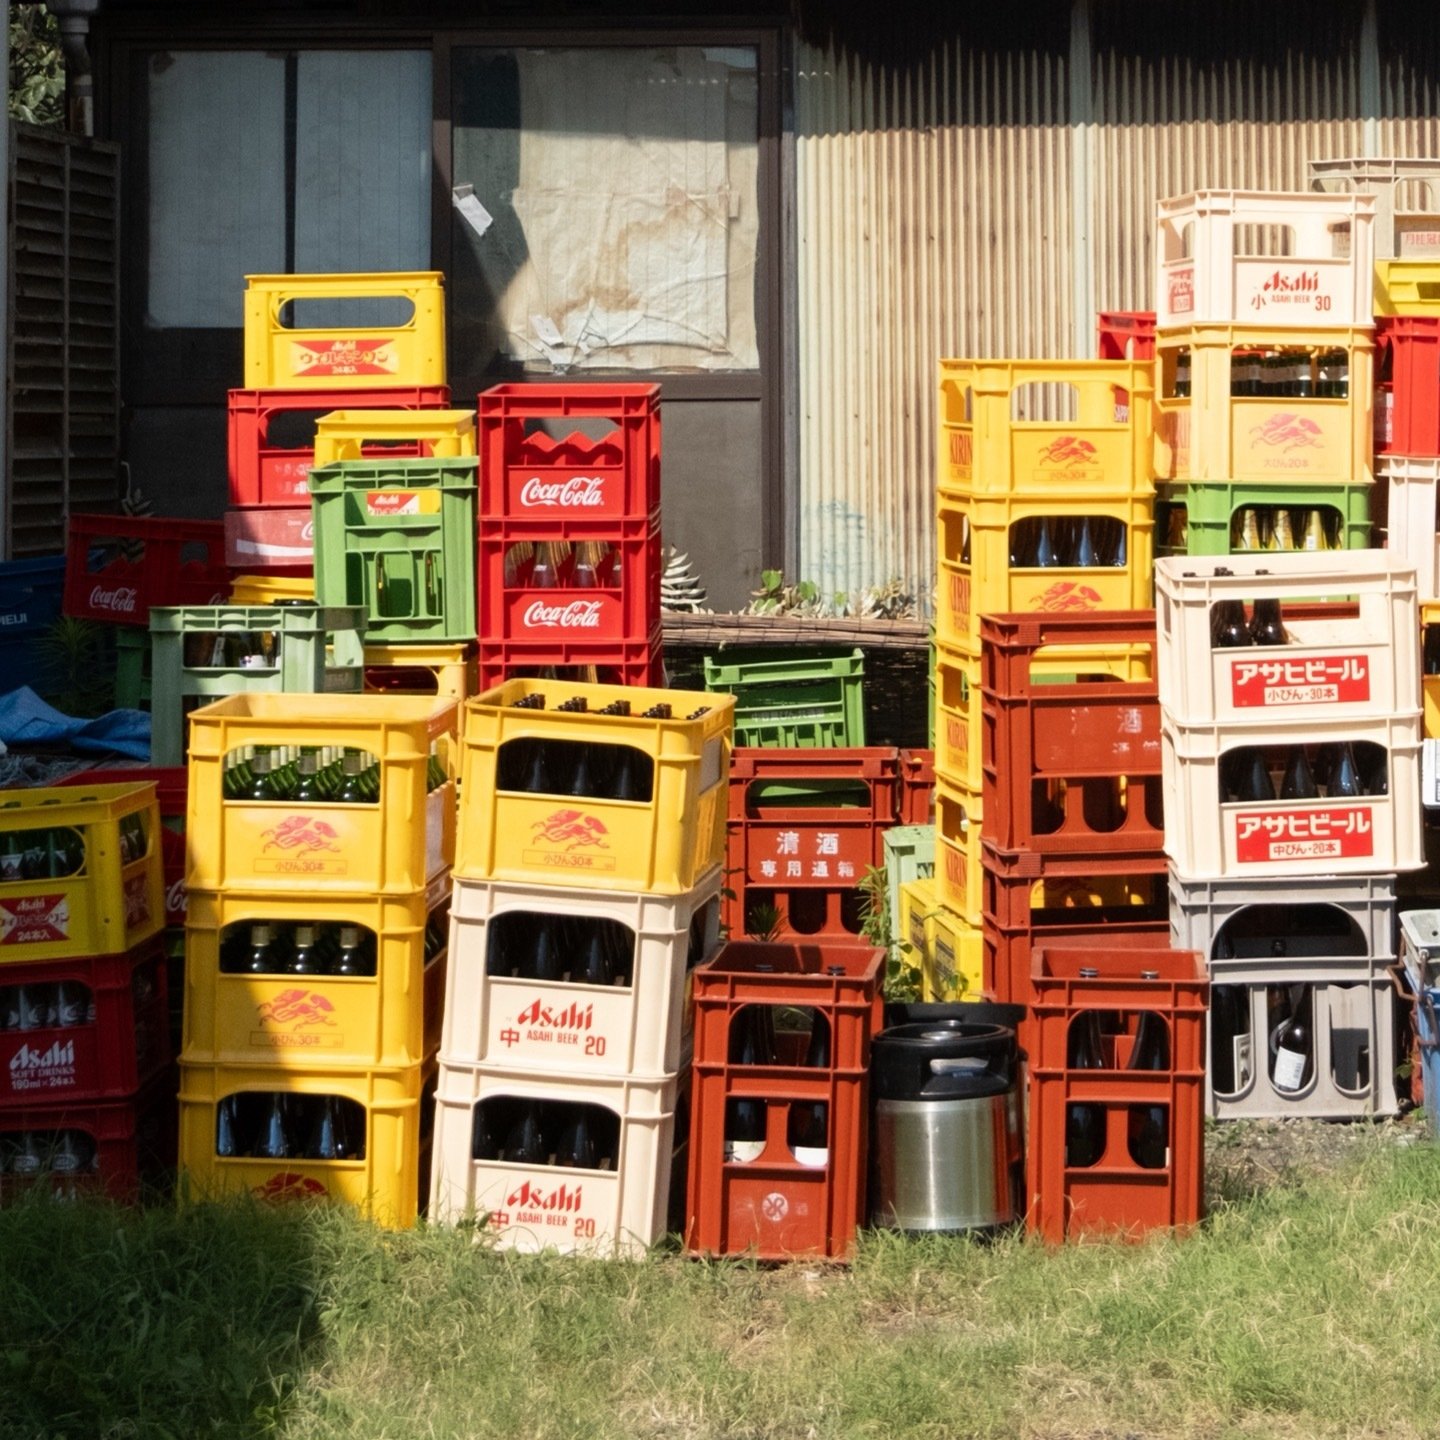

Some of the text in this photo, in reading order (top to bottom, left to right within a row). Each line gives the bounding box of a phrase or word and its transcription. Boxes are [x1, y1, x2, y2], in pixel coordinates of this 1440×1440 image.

[1264, 271, 1318, 292] Asahi
[1251, 294, 1267, 310] 小
[1315, 296, 1331, 311] 30
[521, 478, 603, 506] Coca-Cola
[90, 585, 136, 611] Coca-Cola
[524, 601, 602, 627] Coca-Cola
[1235, 659, 1366, 686] アサヒビール
[1238, 813, 1371, 839] アサヒビール
[776, 830, 839, 855] 清酒
[517, 998, 593, 1030] Asahi
[499, 1027, 520, 1049] 中
[527, 1029, 579, 1045] ASAHI BEER
[584, 1035, 606, 1056] 20
[10, 1040, 74, 1069] Asahi
[507, 1180, 582, 1212] Asahi
[516, 1211, 568, 1227] ASAHI BEER
[574, 1217, 596, 1238] 20
